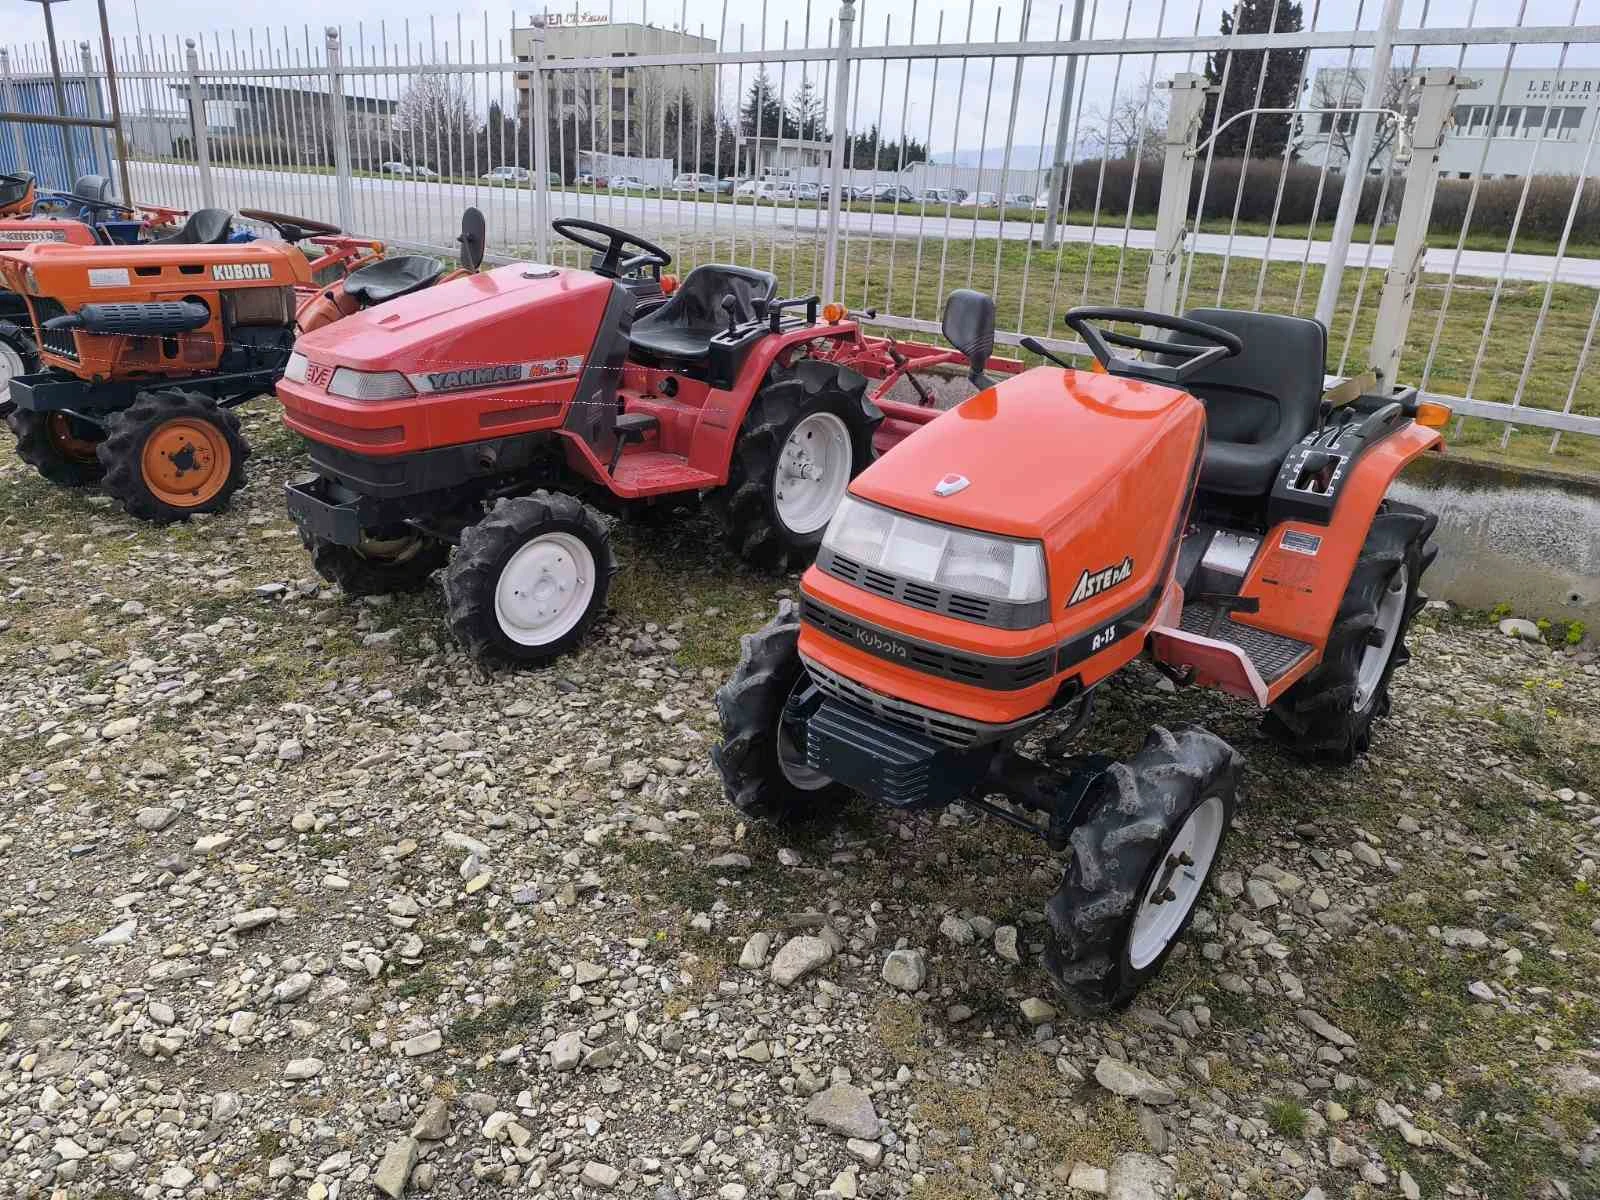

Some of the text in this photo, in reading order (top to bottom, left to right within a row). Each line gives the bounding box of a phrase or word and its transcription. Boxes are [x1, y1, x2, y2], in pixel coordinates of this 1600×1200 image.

[211, 263, 271, 281] KUBOTA
[428, 365, 522, 389] YANMAR
[856, 627, 907, 659] Kubota
